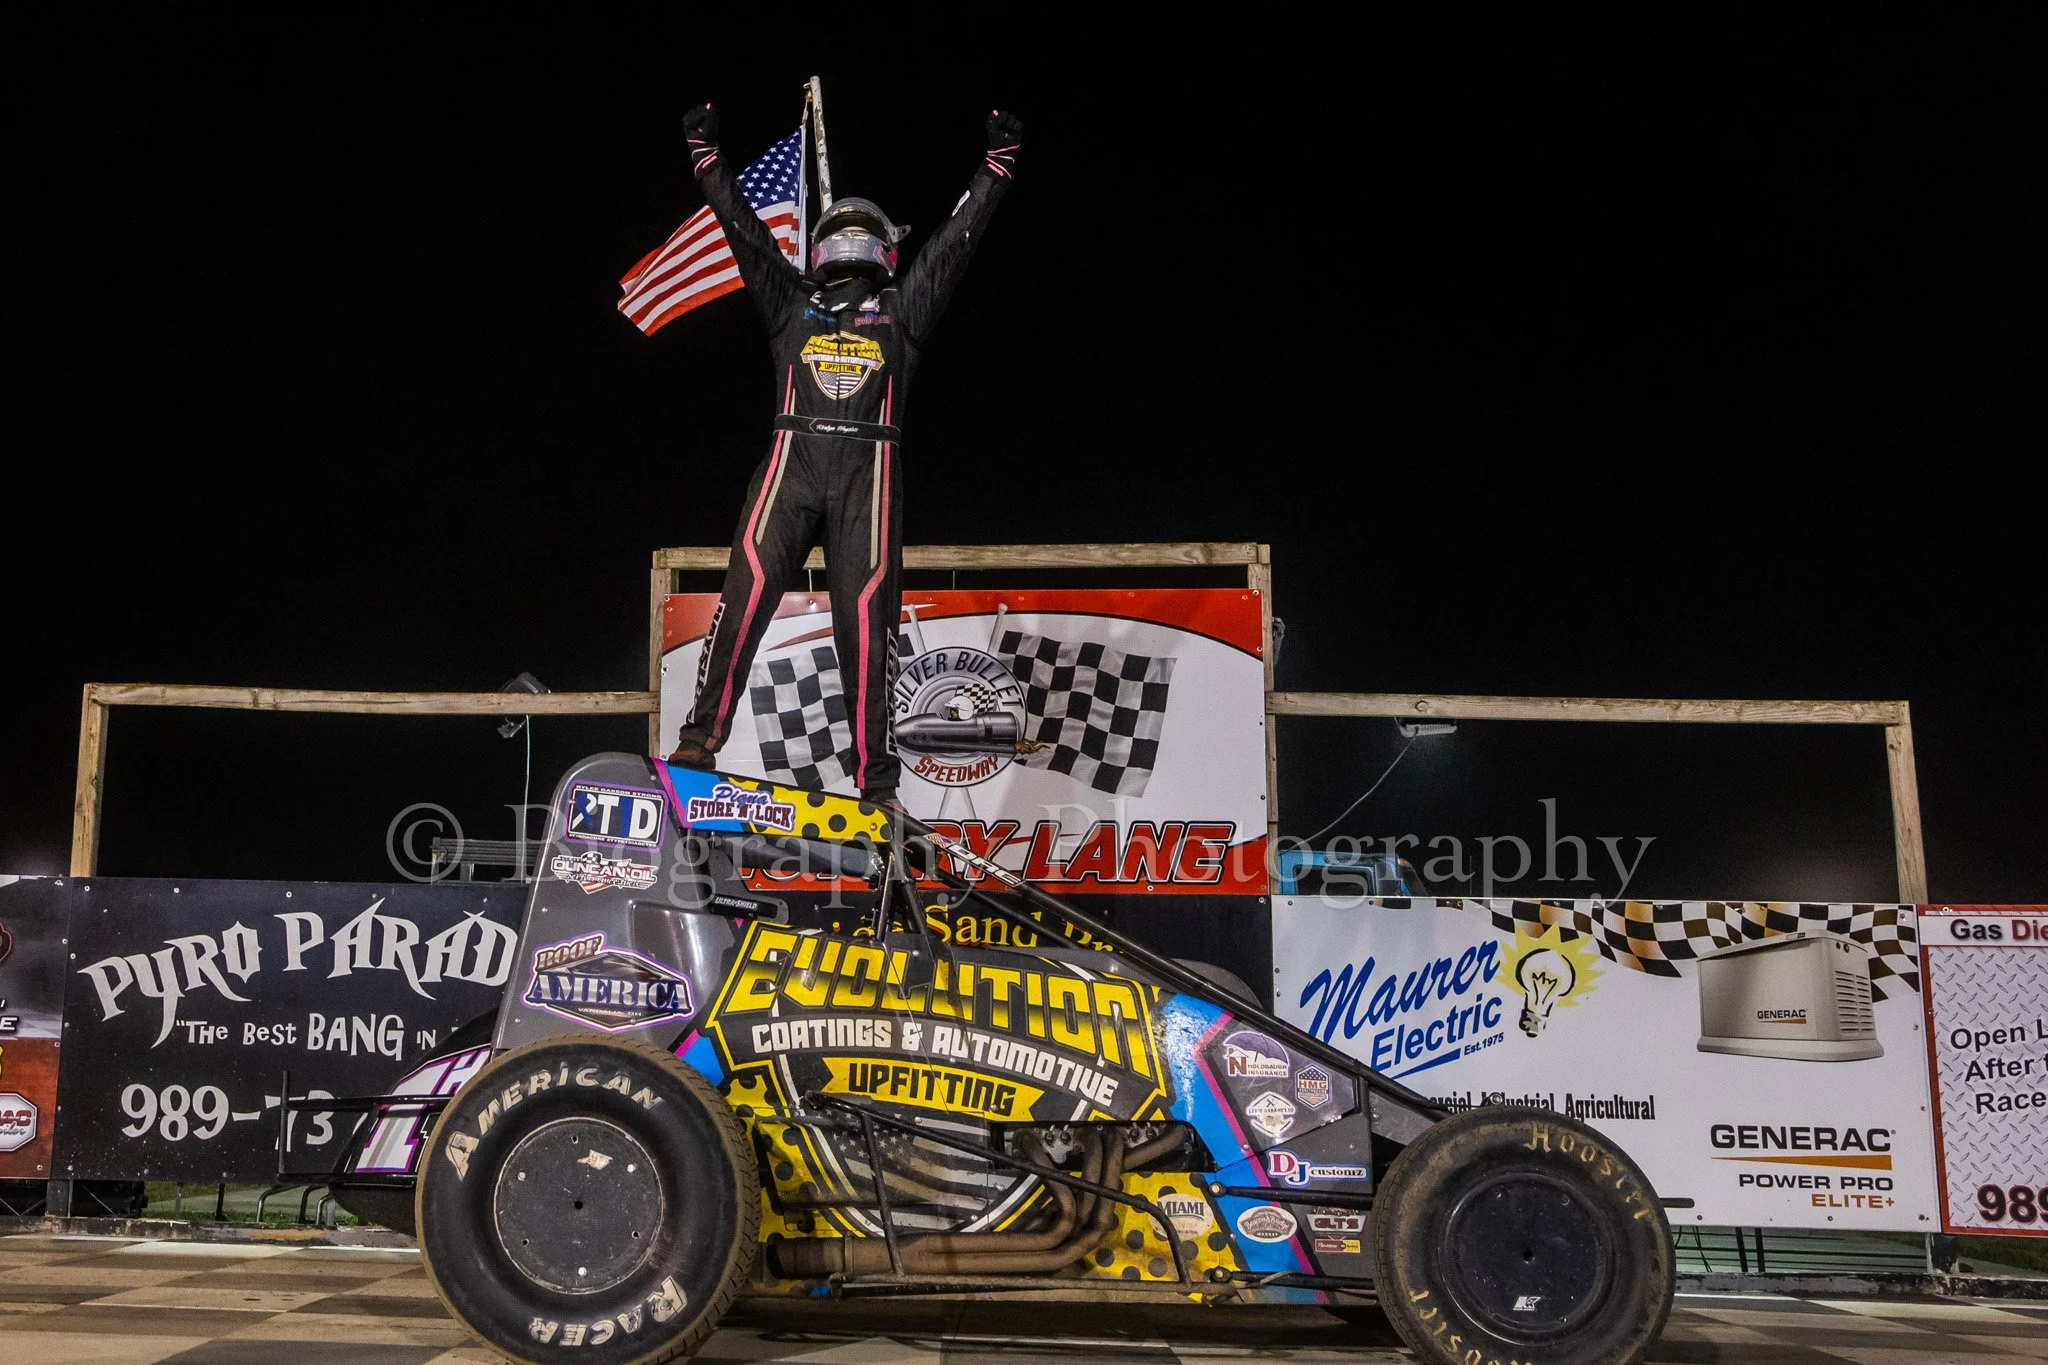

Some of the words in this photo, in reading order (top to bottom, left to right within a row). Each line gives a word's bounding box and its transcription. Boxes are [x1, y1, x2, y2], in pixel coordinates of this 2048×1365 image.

[894, 652, 949, 714] SILVER
[954, 651, 1025, 710] BULLET
[914, 752, 999, 783] SPEEDWAY
[689, 799, 735, 820] STORE
[754, 804, 792, 828] LOCK
[1026, 821, 1235, 884] LANE
[553, 860, 627, 878] DUNCAN
[630, 868, 655, 881] OIL
[1950, 918, 2003, 941] Gas
[536, 937, 601, 970] ROOF
[78, 921, 263, 1050] PYRO
[526, 973, 691, 1011] AMERICA
[1299, 940, 1501, 1046] Maurer
[1756, 1009, 1807, 1020] GENERAC
[307, 1013, 405, 1062] BANG
[1371, 994, 1503, 1073] Electric
[1950, 1025, 2026, 1052] Open
[751, 1018, 893, 1055] COATINGS
[902, 1021, 924, 1051] &
[931, 1026, 1121, 1108] AUTOMOTIVE
[1965, 1057, 2035, 1082] After
[847, 1061, 1017, 1112] UPFITTING
[1298, 1080, 1328, 1089] HMG
[446, 1061, 664, 1182] AMERICAN
[1564, 1093, 1656, 1121] Agricultural
[1710, 1124, 1892, 1152] GENERAC
[1738, 1173, 1831, 1191] POWER
[1840, 1175, 1894, 1192] PRO
[1156, 1200, 1205, 1218] MIAMI
[1811, 1193, 1896, 1209] ELITE+
[529, 1275, 688, 1347] RACER
